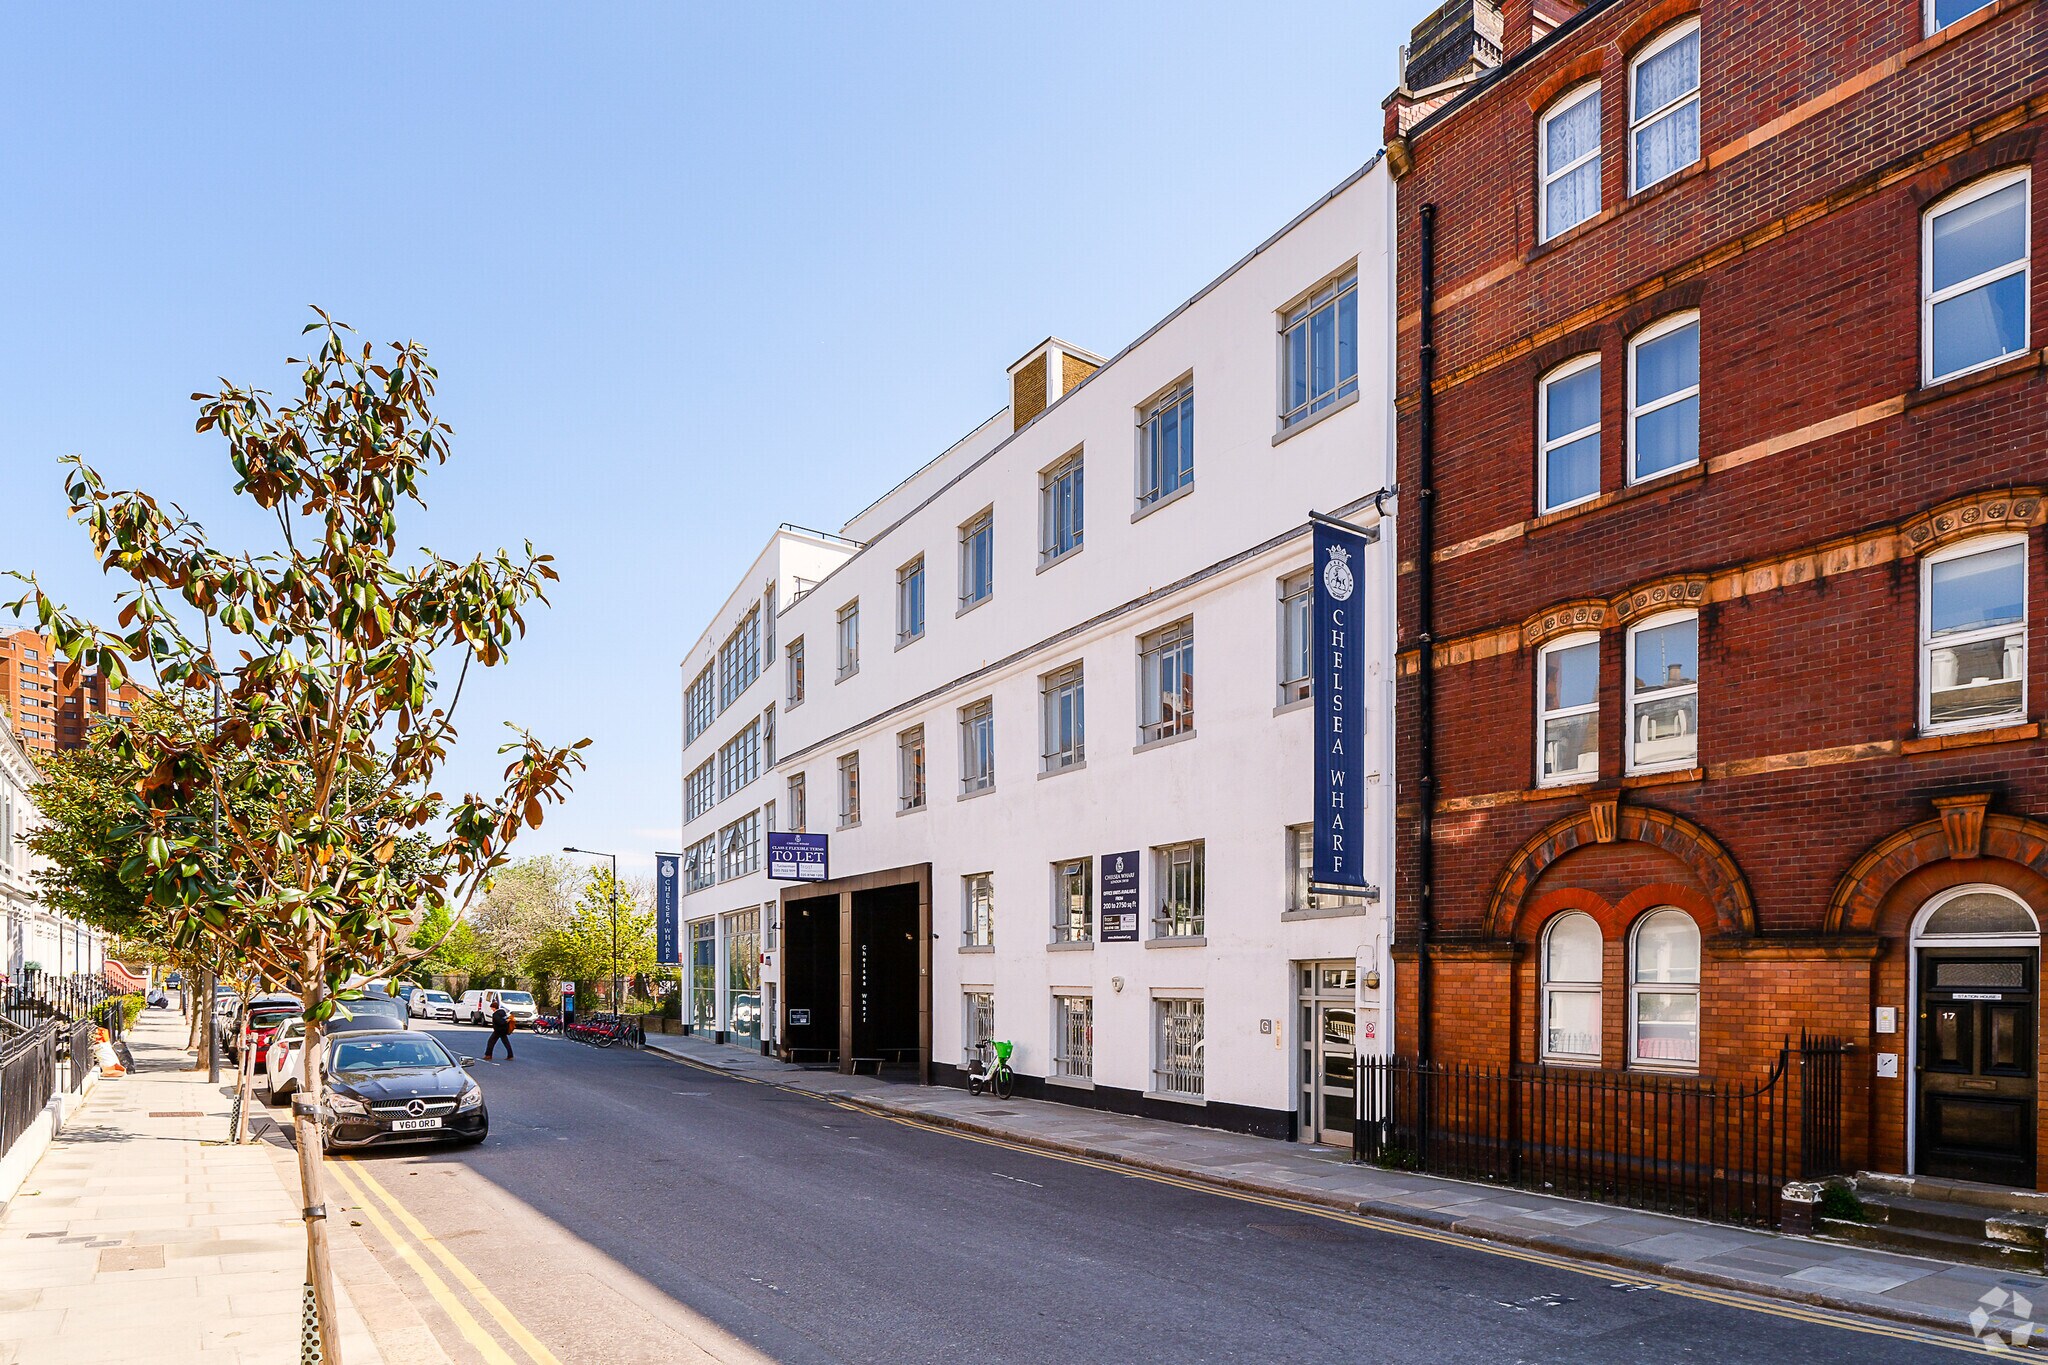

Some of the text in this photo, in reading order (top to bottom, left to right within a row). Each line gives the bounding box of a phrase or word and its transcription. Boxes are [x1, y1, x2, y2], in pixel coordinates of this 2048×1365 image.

[1331, 609, 1345, 755] CHELSEA
[1331, 769, 1345, 873] WHARF
[772, 850, 824, 862] TO LET
[1262, 1021, 1269, 1032] G
[399, 1119, 436, 1129] V60 ORD
